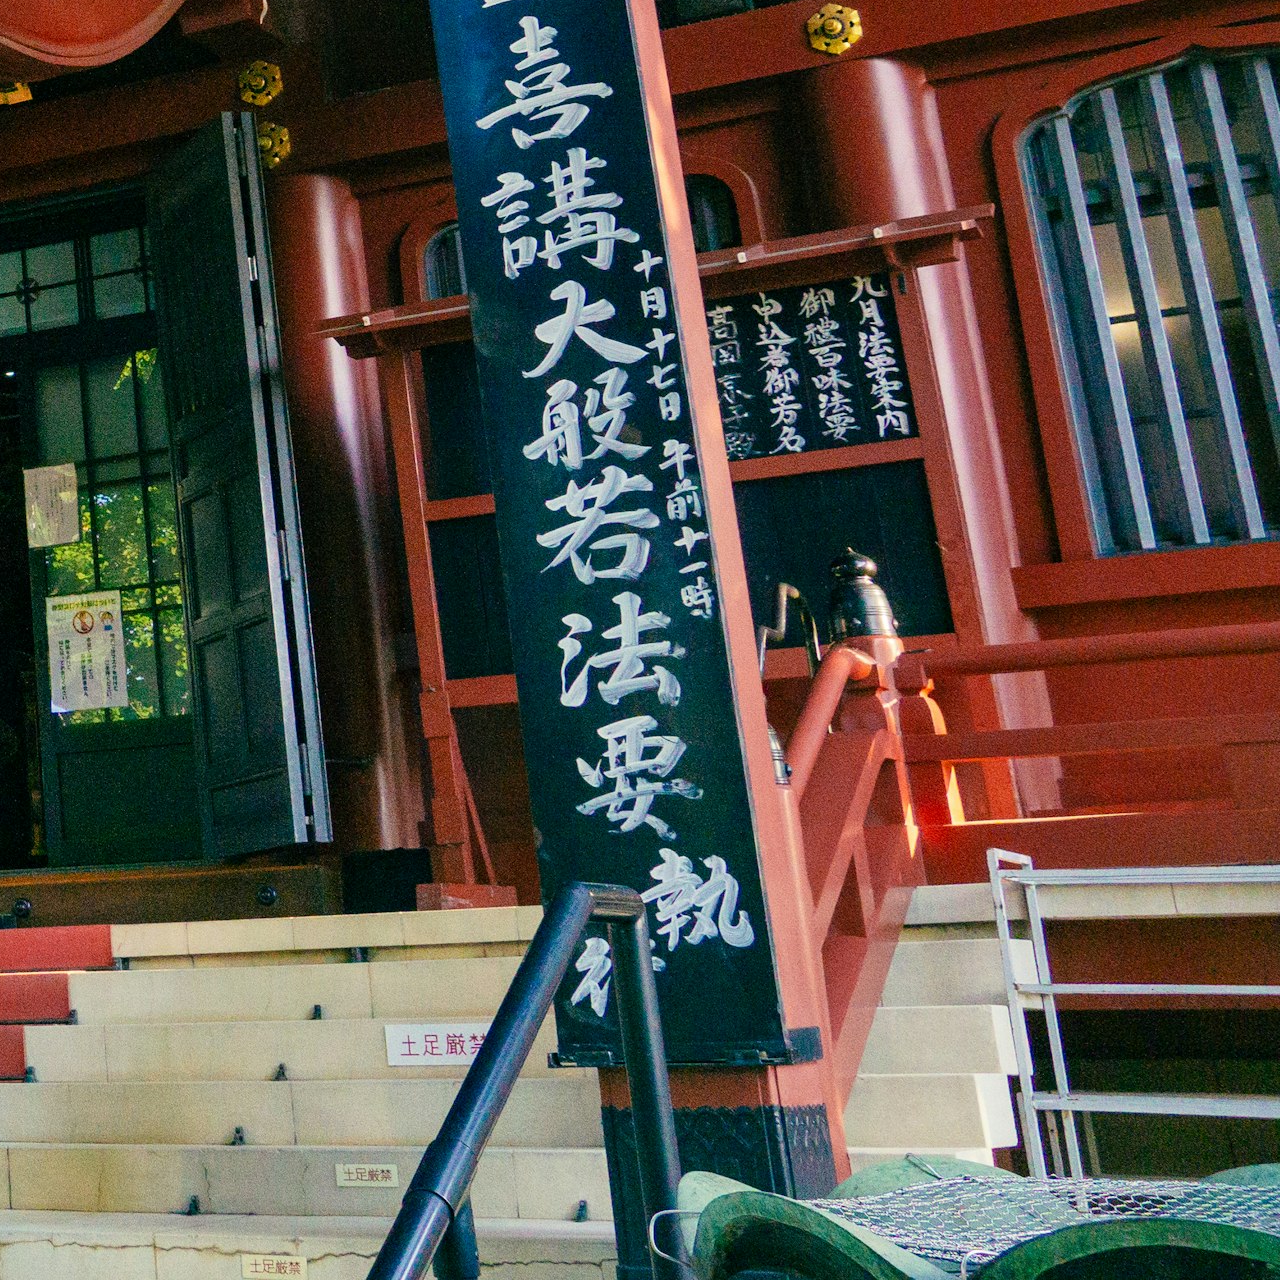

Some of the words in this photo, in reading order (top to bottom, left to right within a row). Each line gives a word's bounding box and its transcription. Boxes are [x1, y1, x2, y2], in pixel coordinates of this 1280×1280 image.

[343, 1167, 393, 1184] 土足厳禁
[249, 1257, 302, 1277] 土足厳禁
